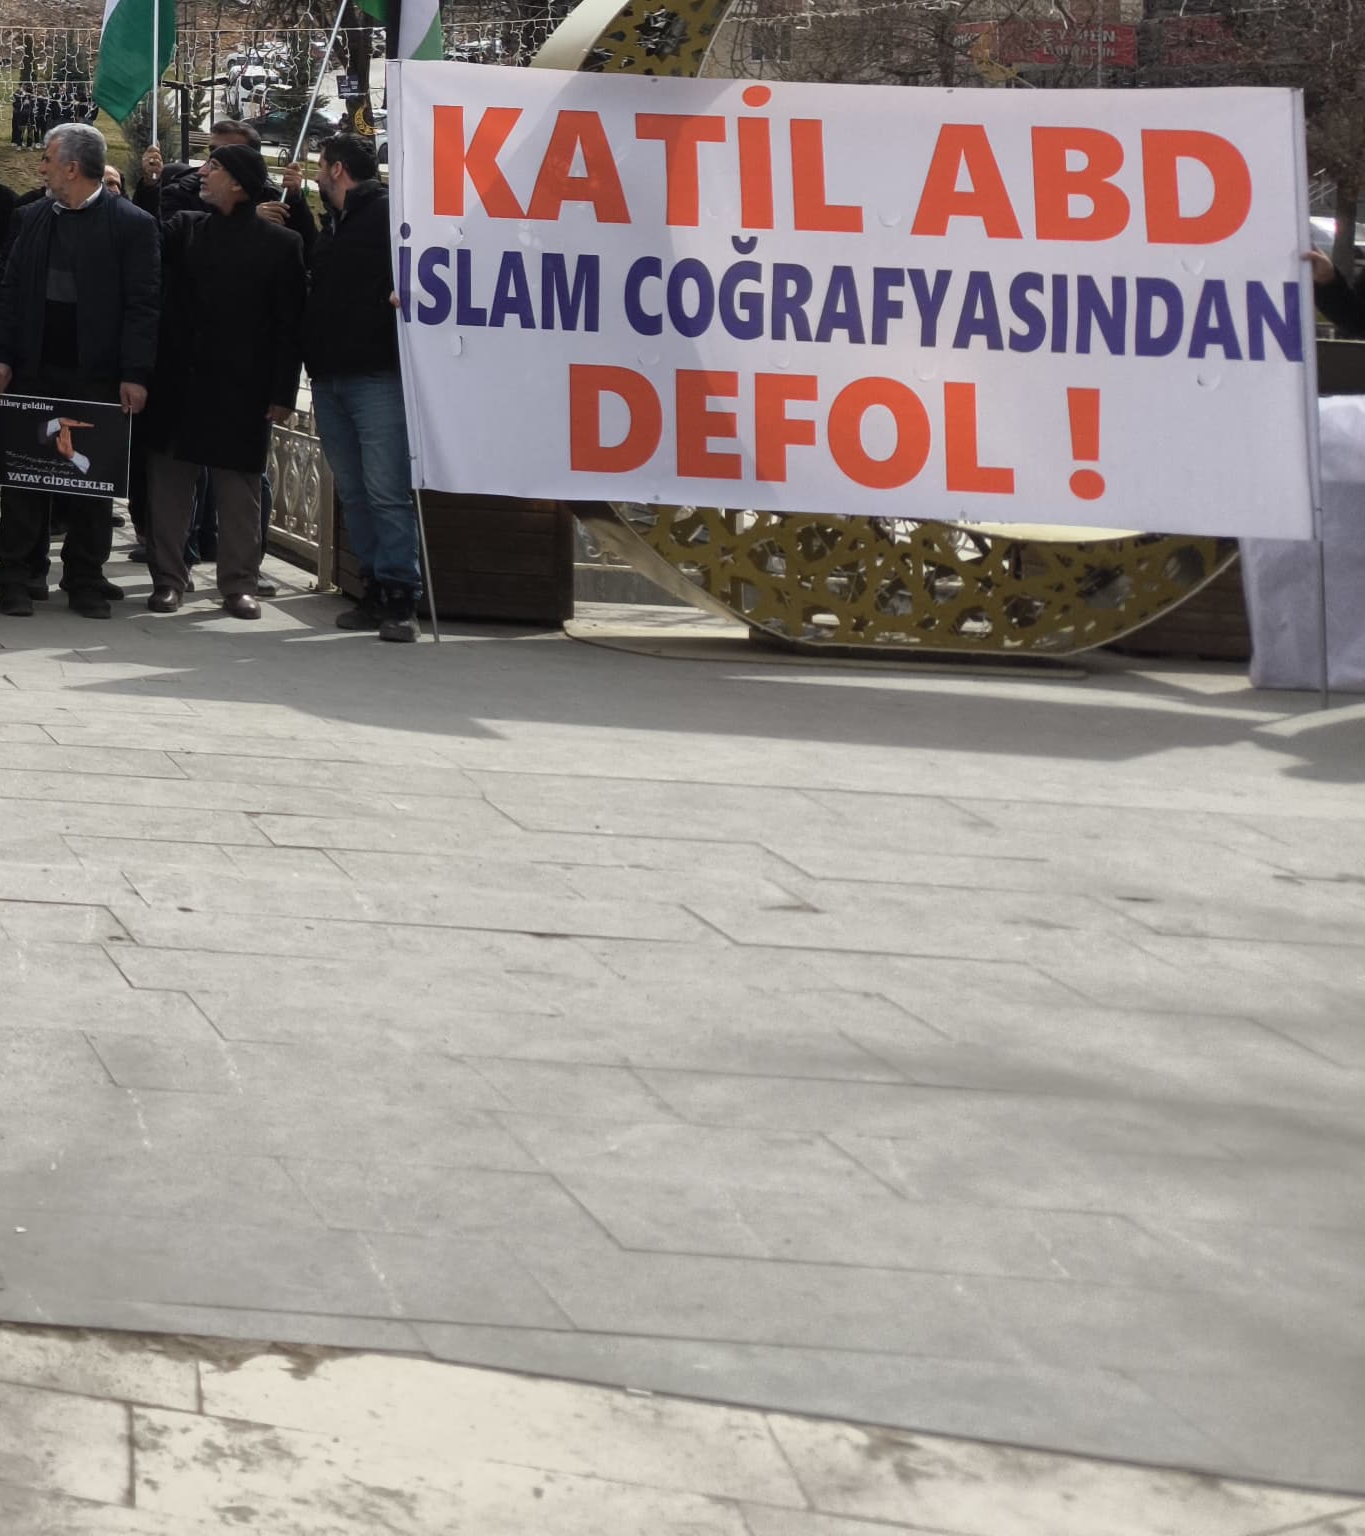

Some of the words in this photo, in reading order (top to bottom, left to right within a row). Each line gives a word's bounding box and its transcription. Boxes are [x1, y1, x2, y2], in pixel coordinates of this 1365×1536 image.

[432, 84, 865, 233] KATİL
[910, 123, 1253, 245] ABD
[398, 222, 599, 332] İSLAM
[623, 235, 1303, 363] COĞRAFYASINDAN
[7, 472, 42, 483] YATAY
[43, 474, 115, 491] GİDECEKLER
[569, 363, 1015, 496] DEFOL
[1066, 387, 1106, 501] !
